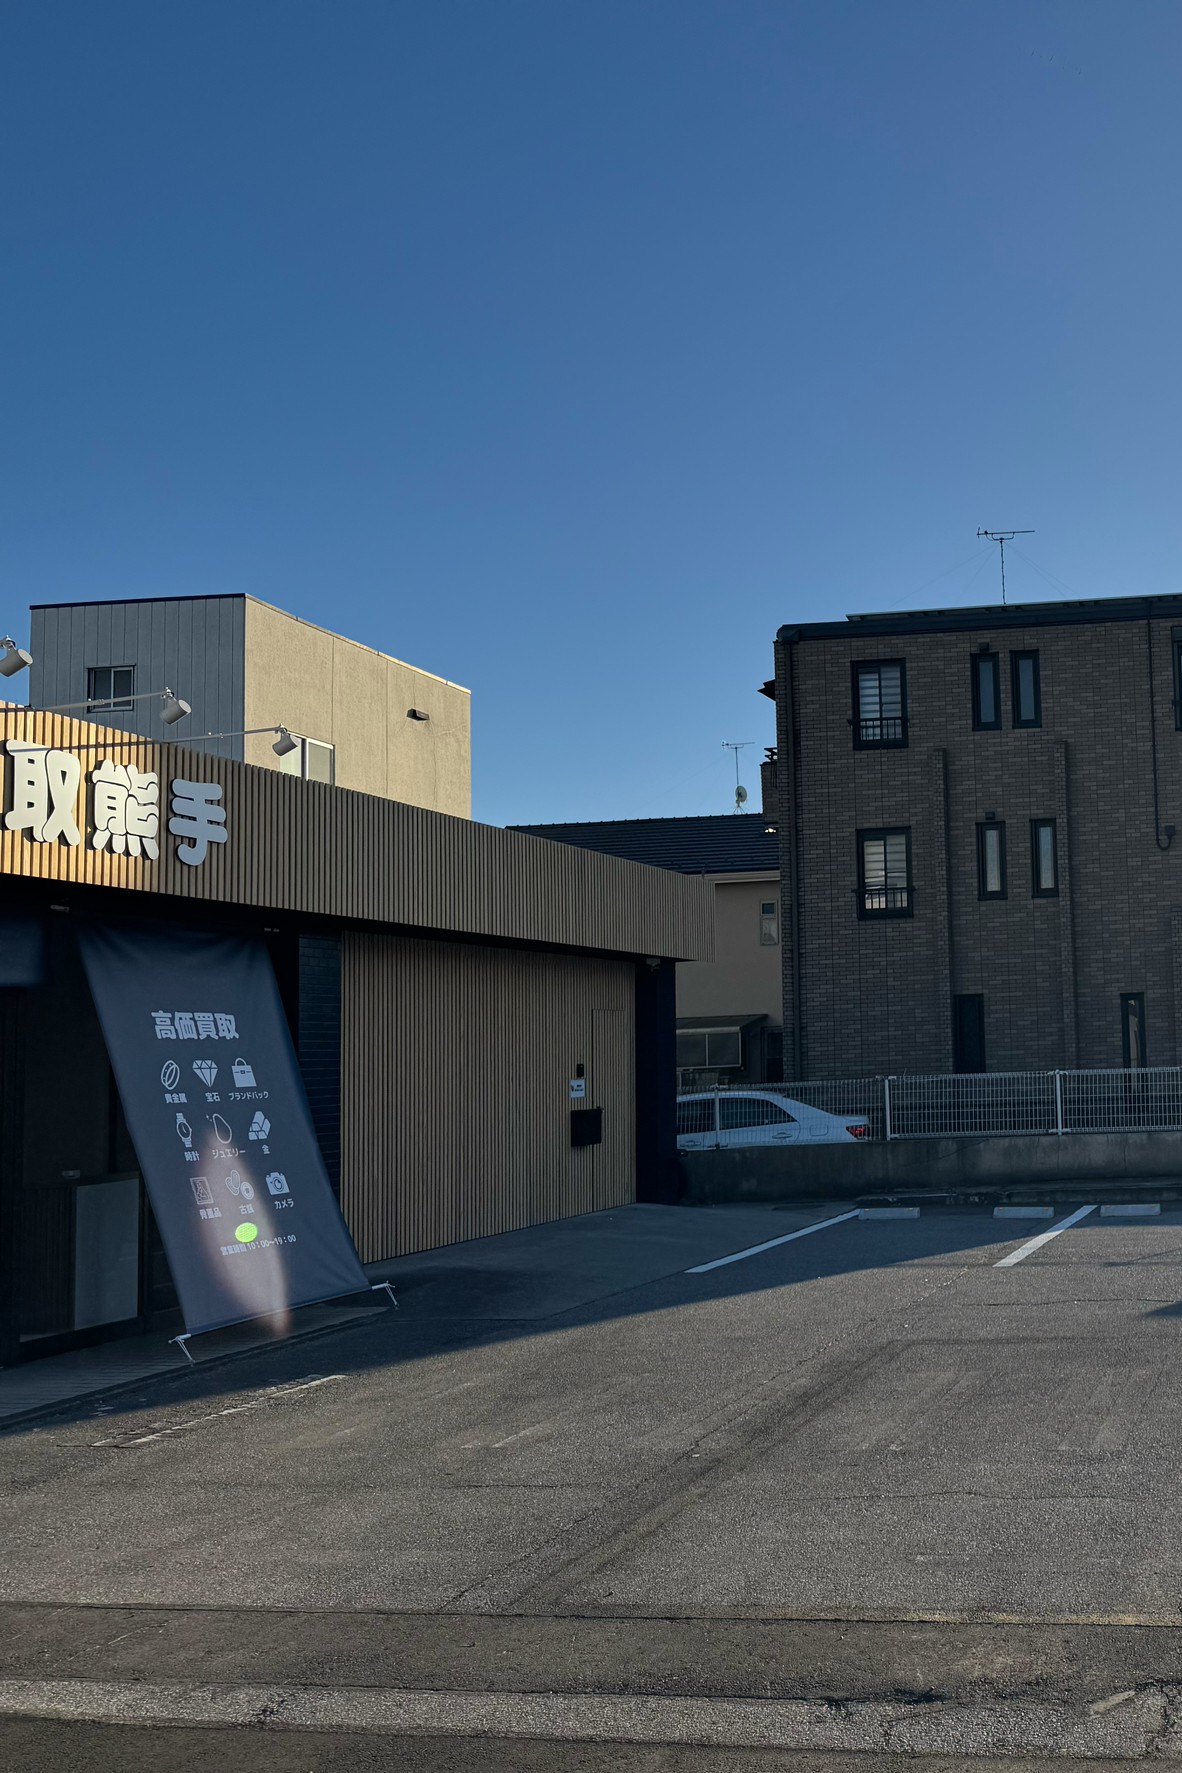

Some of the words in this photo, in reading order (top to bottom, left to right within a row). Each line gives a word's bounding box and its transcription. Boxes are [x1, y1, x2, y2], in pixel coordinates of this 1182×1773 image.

[5, 739, 228, 866] 取熊手
[151, 1010, 239, 1040] 高価買取
[205, 1092, 221, 1102] 宝石
[211, 1148, 246, 1159] ジュエリー
[262, 1144, 270, 1155] 金
[184, 1151, 200, 1162] 時計
[274, 1198, 294, 1210] カメラ
